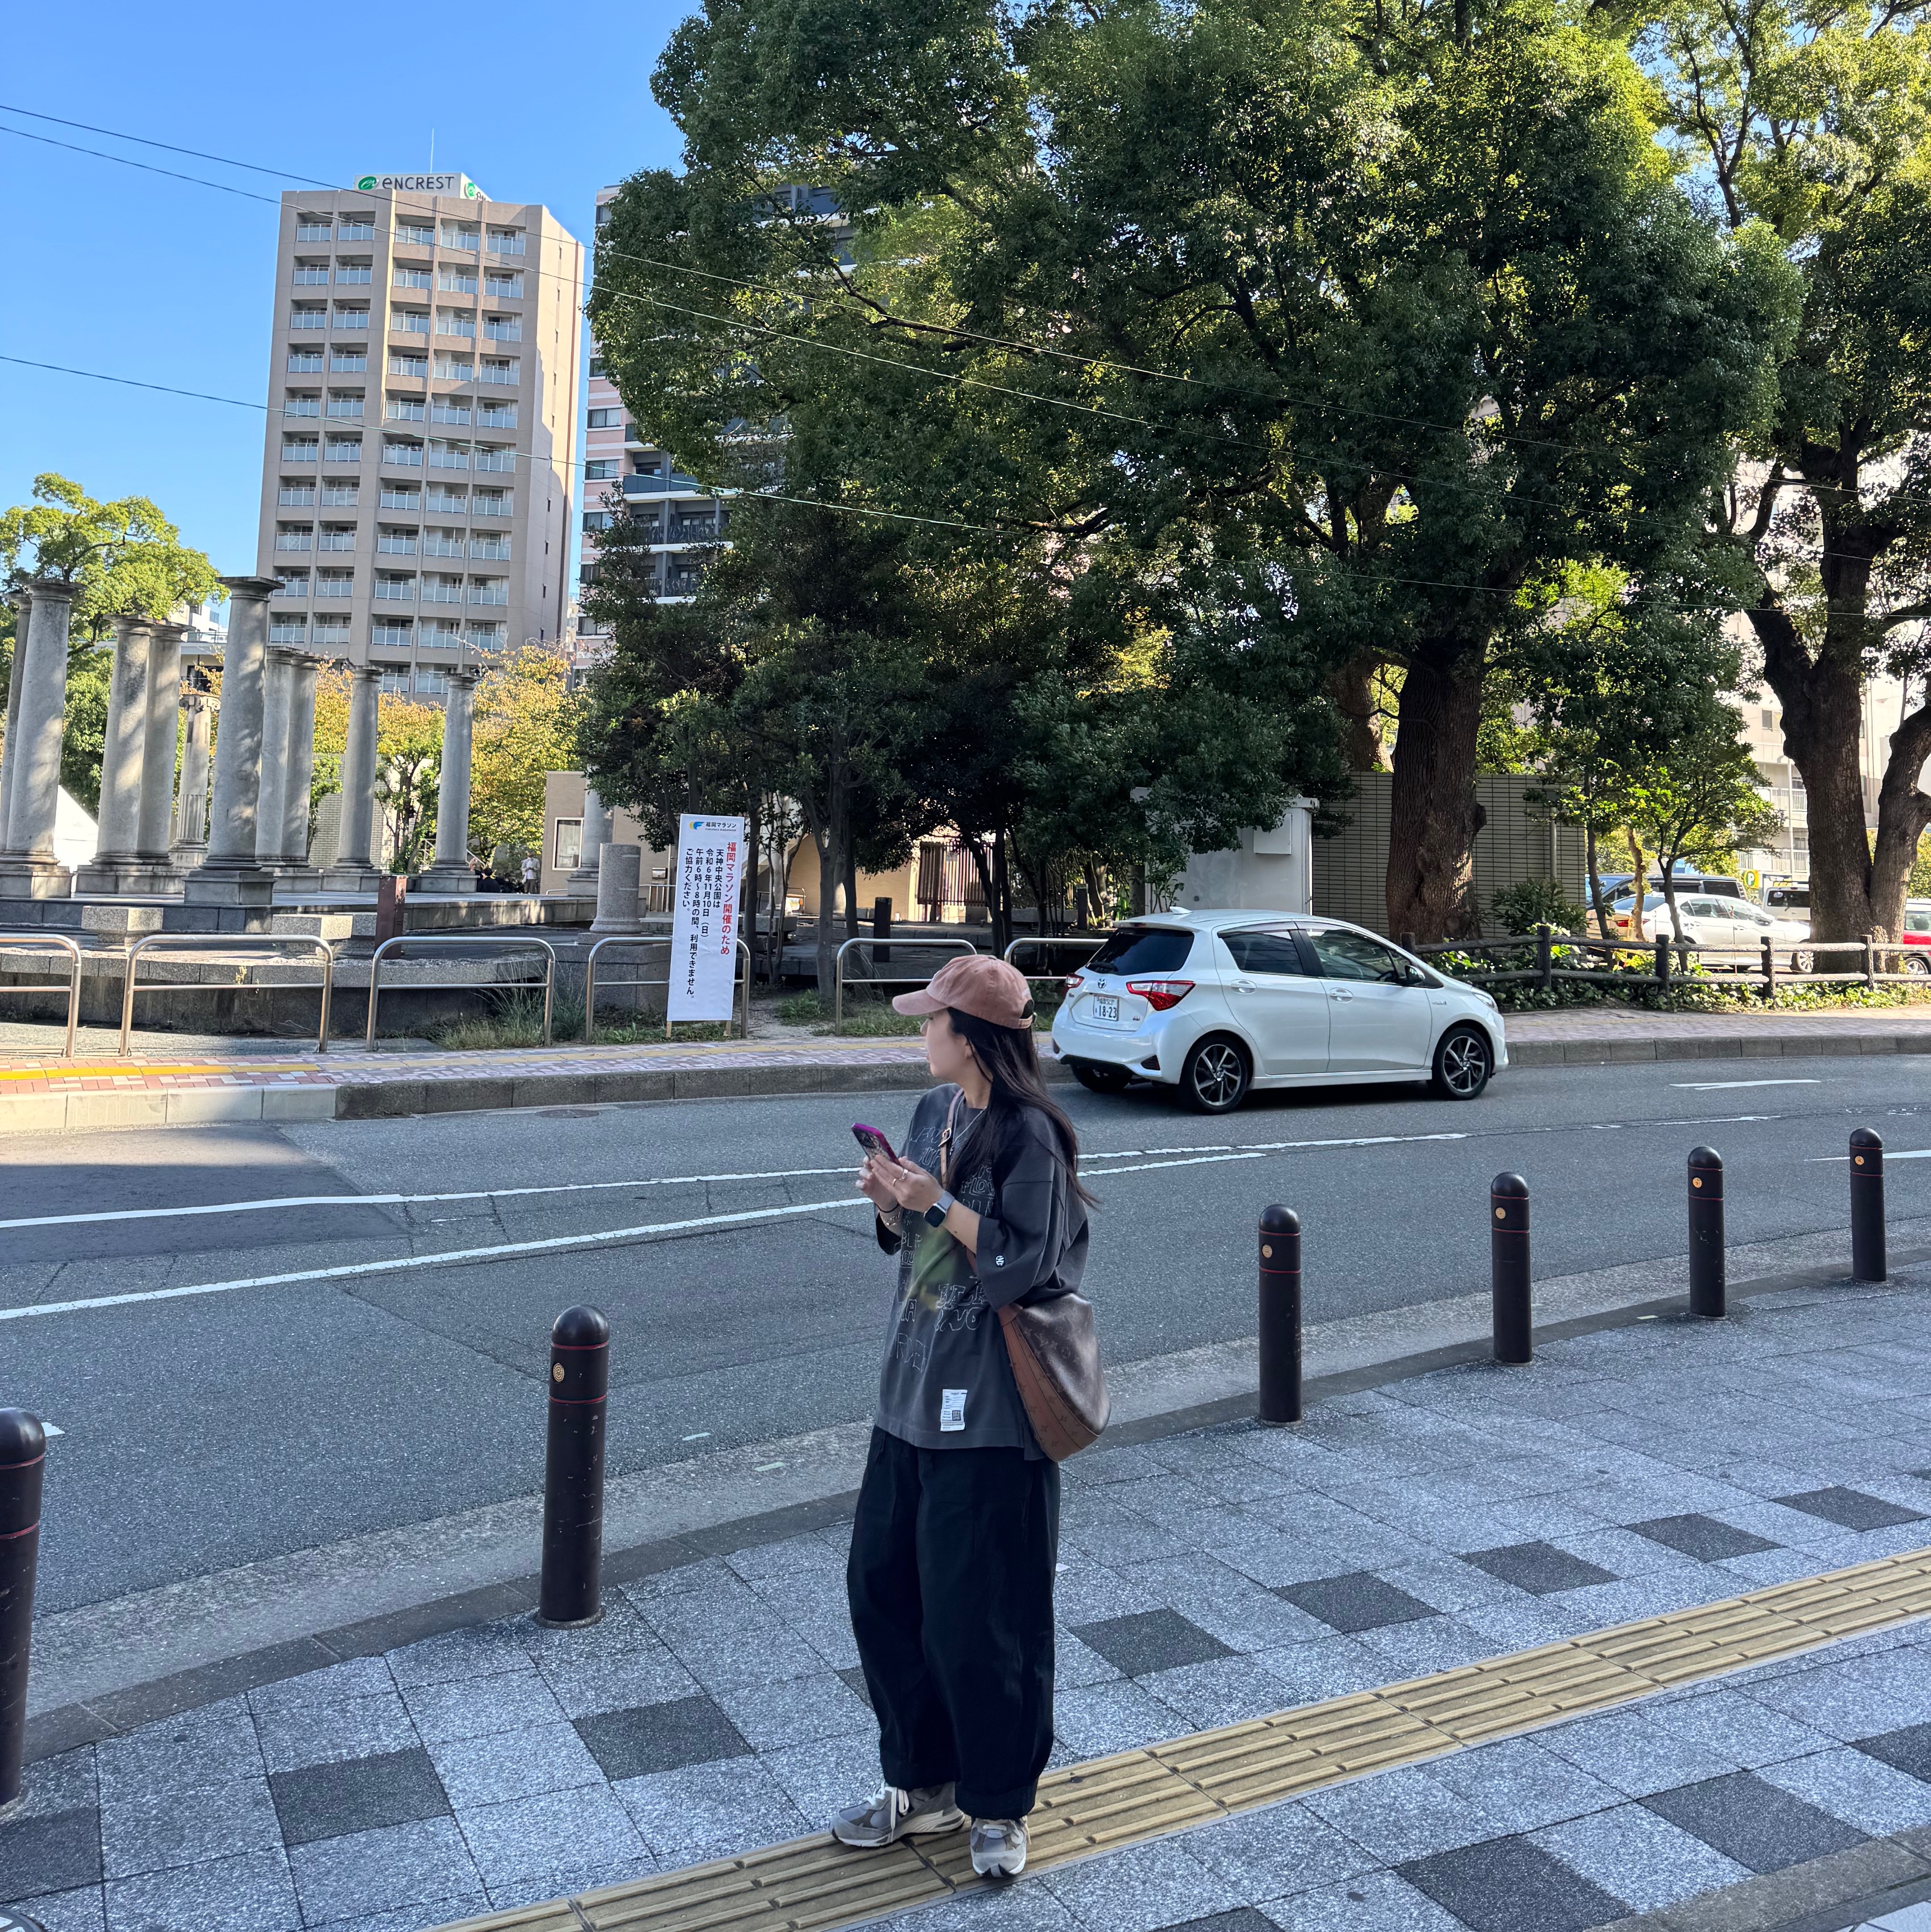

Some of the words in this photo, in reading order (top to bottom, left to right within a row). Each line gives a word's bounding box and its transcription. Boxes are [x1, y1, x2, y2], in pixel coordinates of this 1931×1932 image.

[683, 848, 694, 912] ご協力ください。
[713, 849, 724, 908] 天神中央公園は
[720, 842, 737, 955] 福岡マラソン開催のため
[1747, 872, 1755, 886] P
